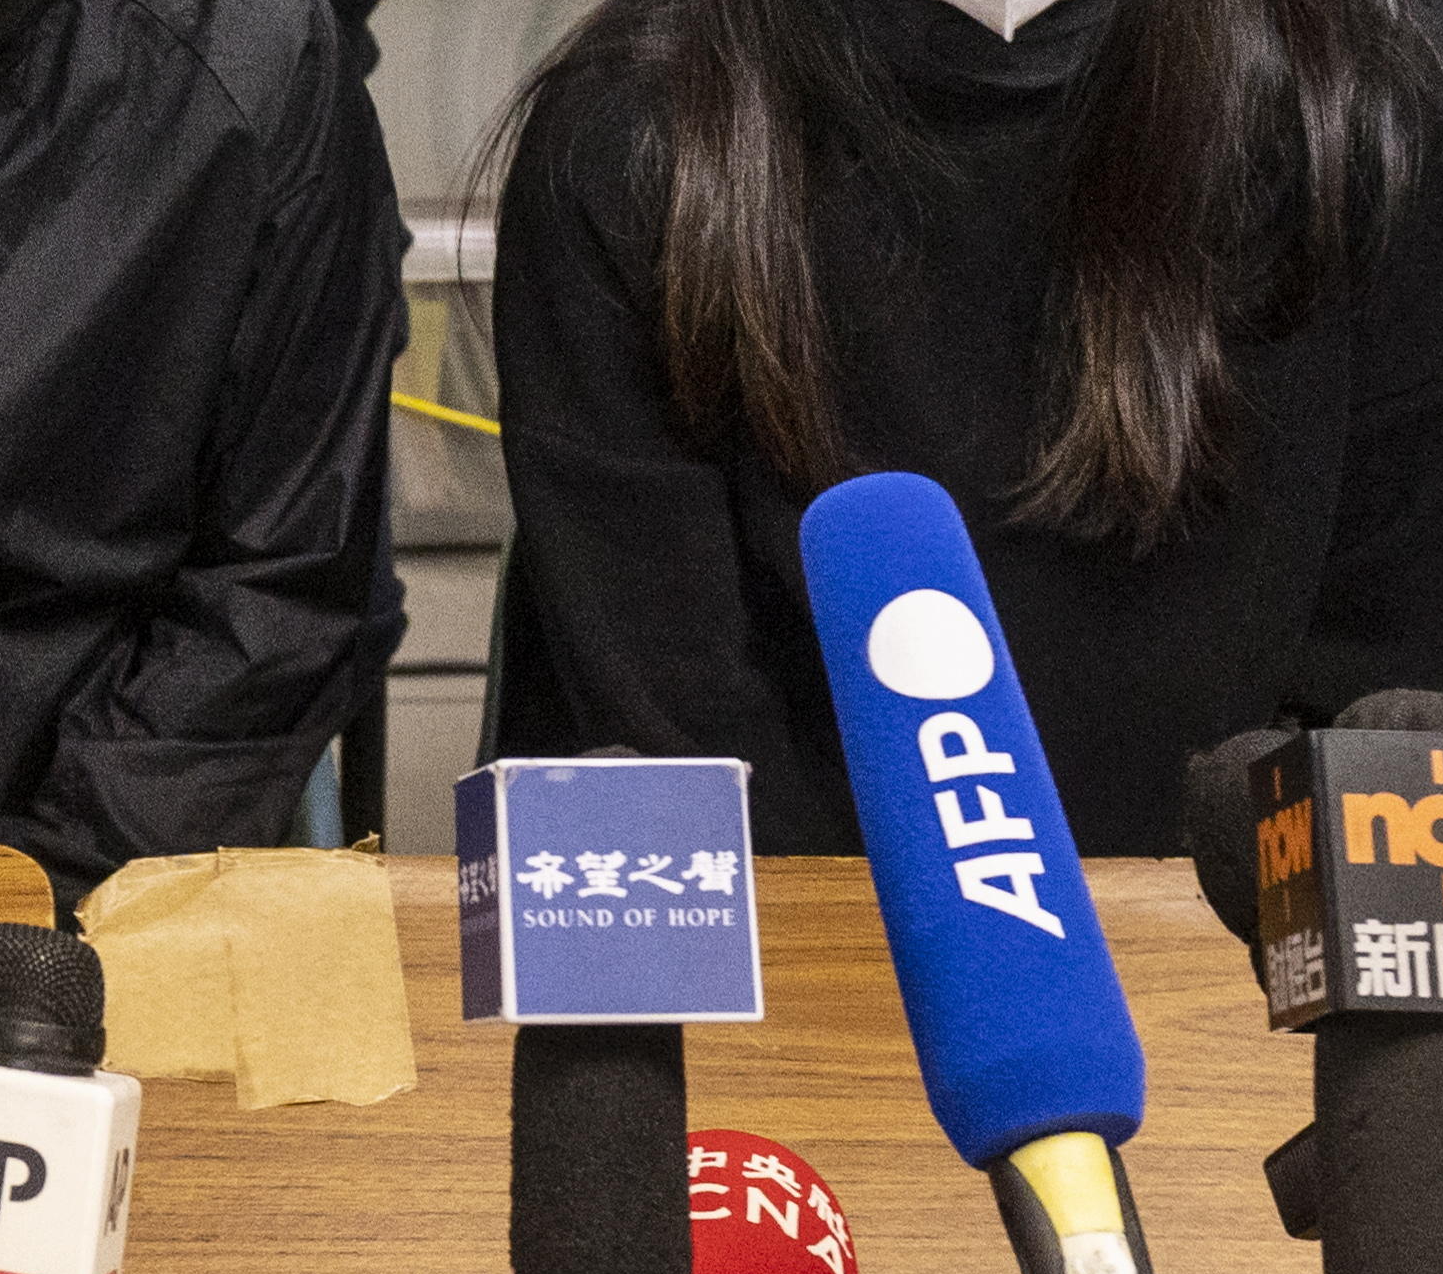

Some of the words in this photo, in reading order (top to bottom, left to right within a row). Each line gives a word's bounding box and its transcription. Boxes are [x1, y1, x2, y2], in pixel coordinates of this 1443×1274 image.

[916, 711, 1066, 940] AFP
[516, 849, 740, 900] 希望之聲
[522, 908, 614, 929] SOUND
[623, 908, 658, 927] OF
[668, 908, 737, 927] HOPE
